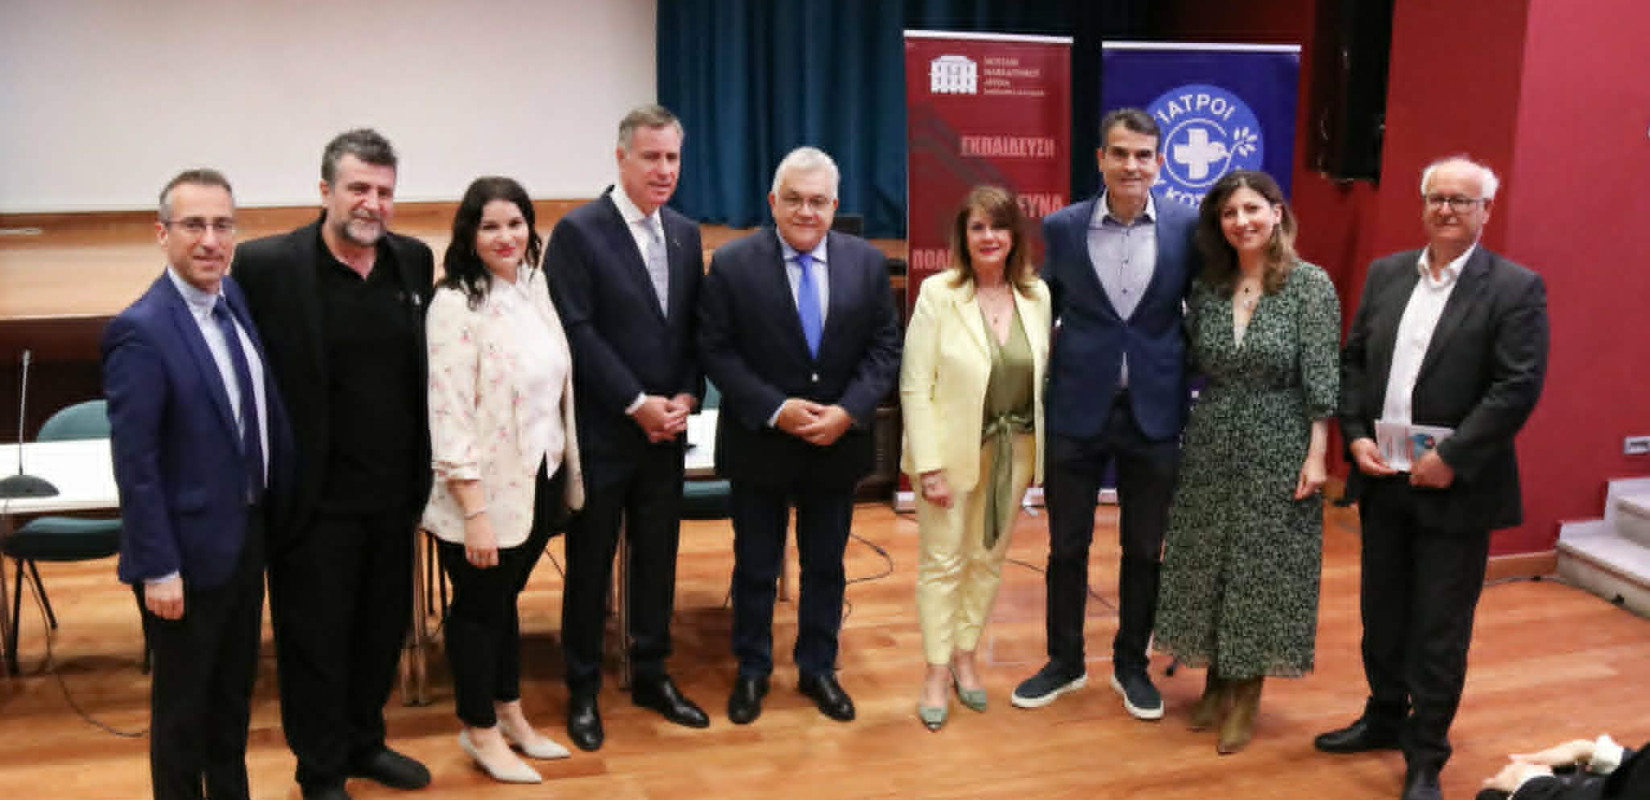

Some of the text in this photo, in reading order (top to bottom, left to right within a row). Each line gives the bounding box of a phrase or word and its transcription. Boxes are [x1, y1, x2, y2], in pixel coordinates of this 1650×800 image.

[1154, 94, 1236, 124] ΙΑΤΡΟΙ
[960, 136, 1055, 158] ΕΚΠΑΙΔΕΥΣΗ
[1015, 192, 1064, 218] ΕΥΝΑ
